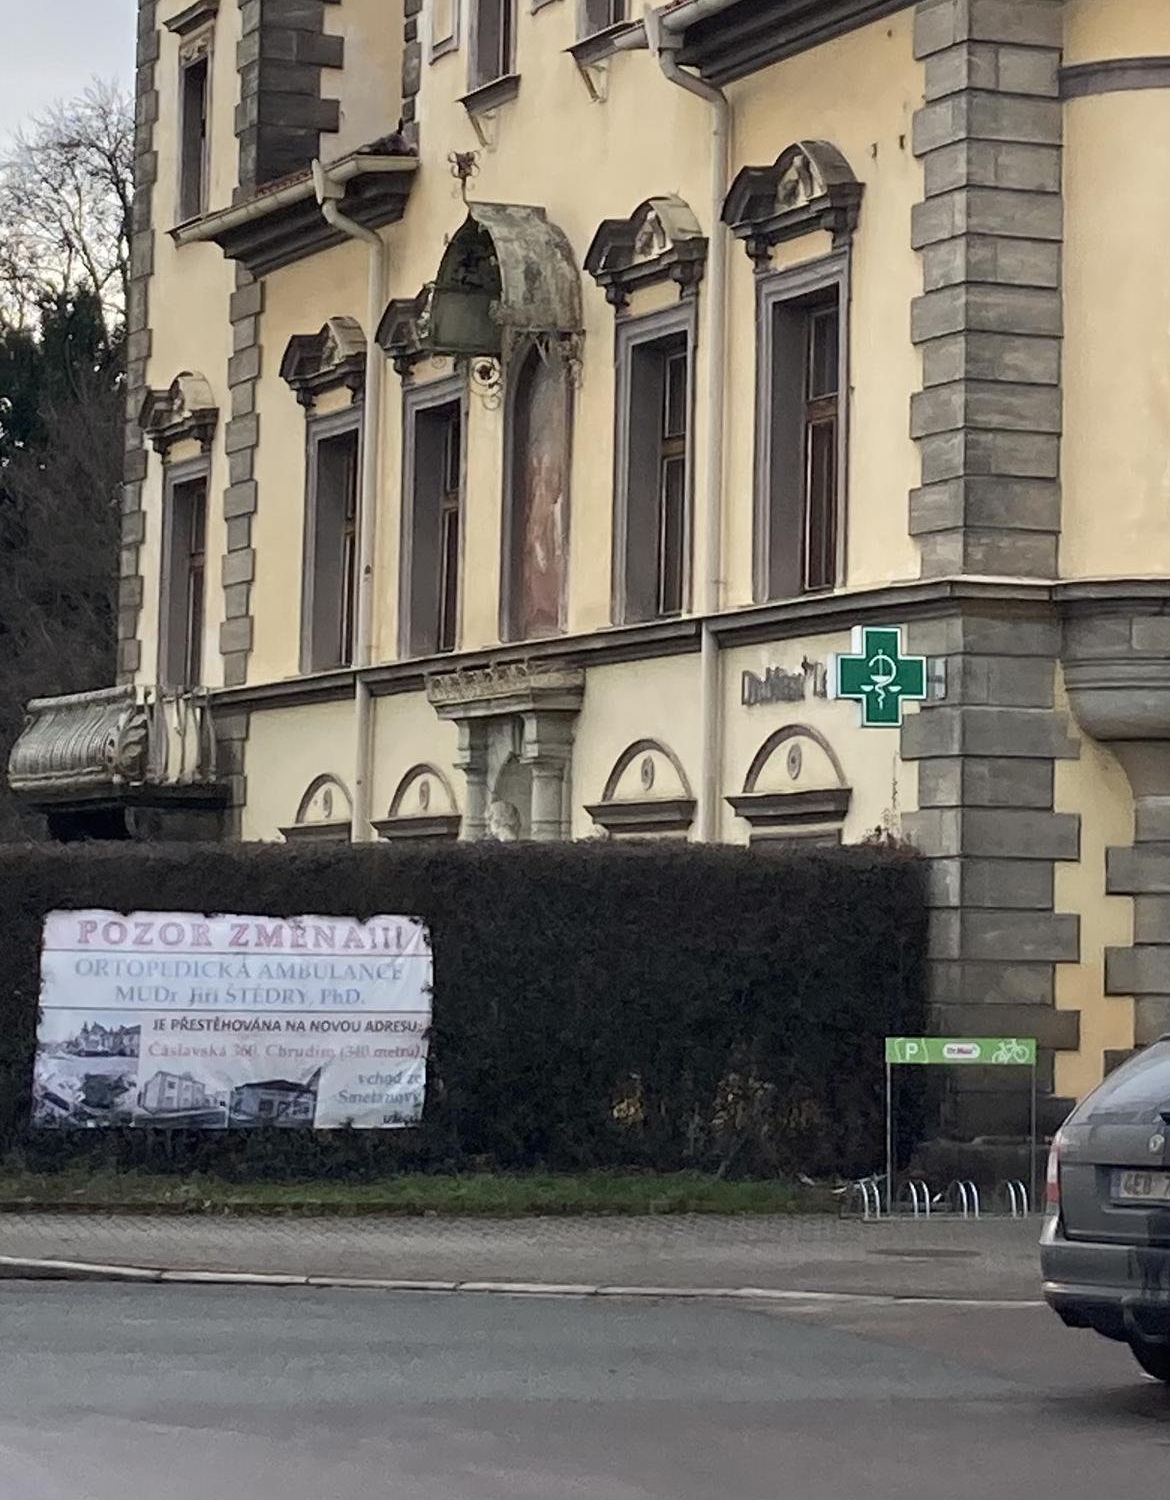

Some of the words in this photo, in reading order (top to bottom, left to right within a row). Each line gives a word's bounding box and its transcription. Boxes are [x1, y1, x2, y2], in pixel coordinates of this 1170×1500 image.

[77, 920, 213, 947] POZOR
[75, 955, 251, 979] ORTOPEDICKÁ
[258, 962, 402, 980] AMBULANCE
[320, 987, 365, 1005] PhD.
[152, 1018, 166, 1031] JE
[170, 1016, 281, 1032] PŘESTĚHOVÁNA
[285, 1020, 306, 1032] NA
[310, 1020, 361, 1032] NOVOU
[905, 1042, 918, 1061] P
